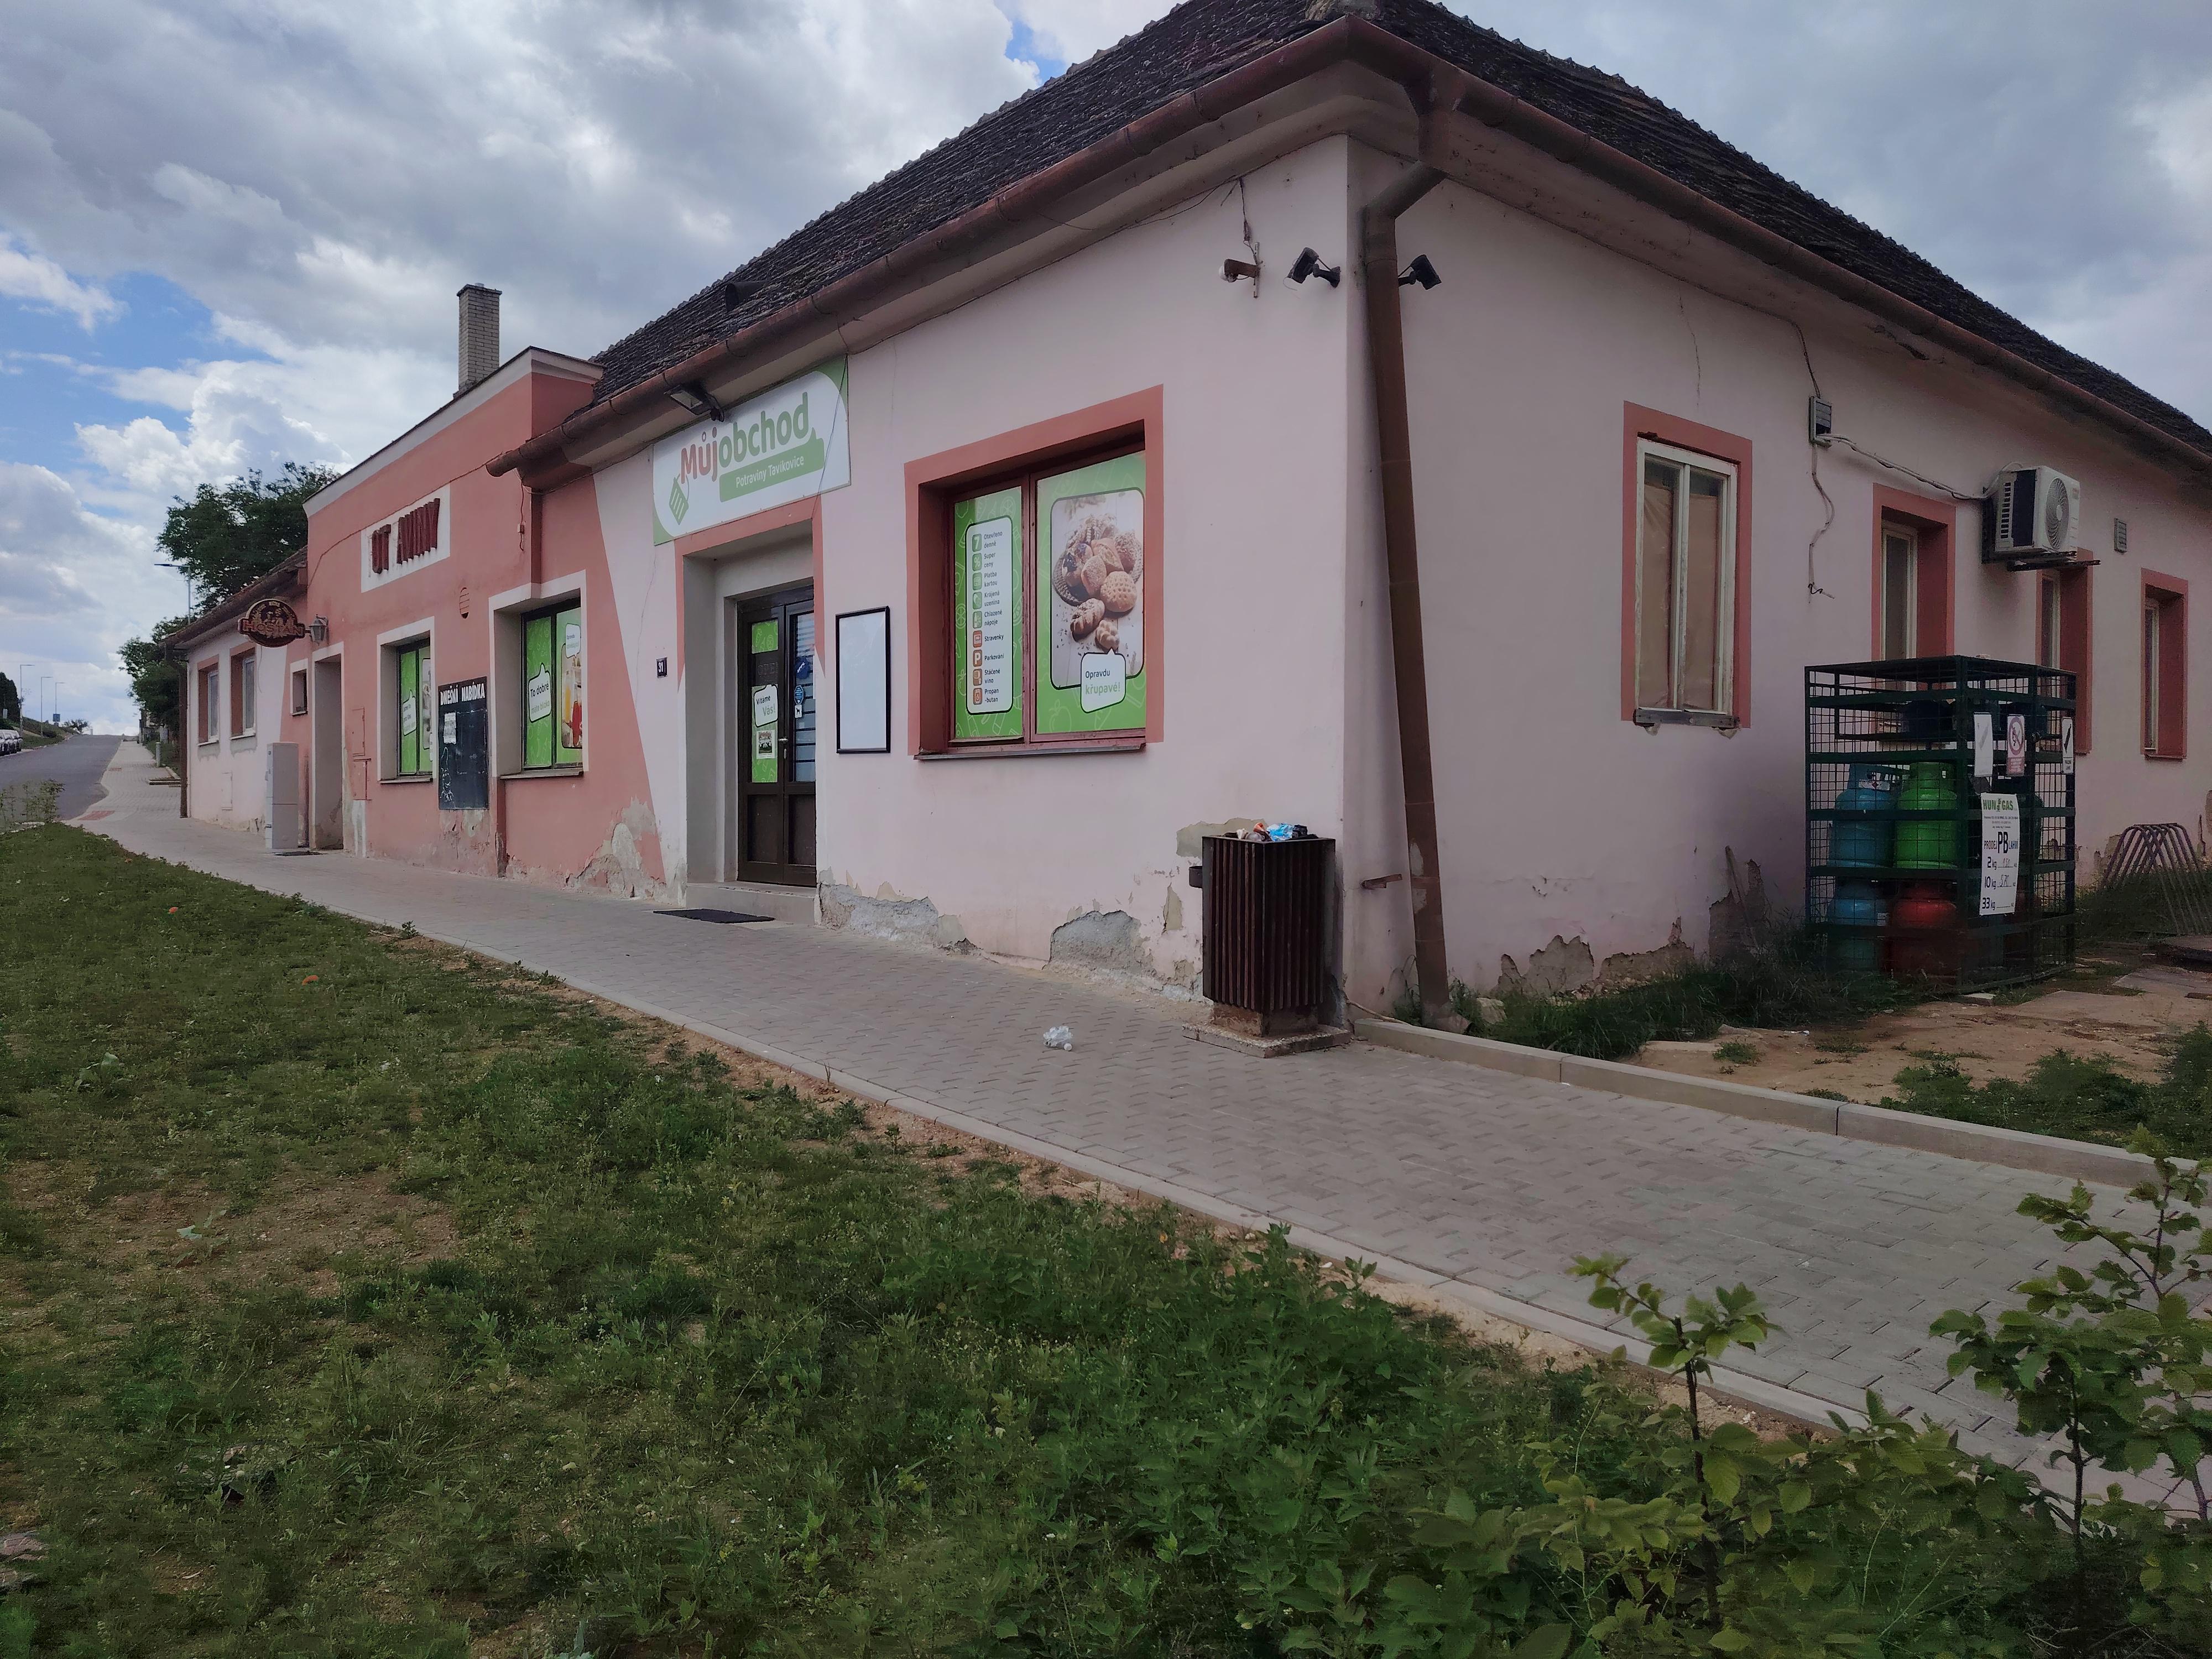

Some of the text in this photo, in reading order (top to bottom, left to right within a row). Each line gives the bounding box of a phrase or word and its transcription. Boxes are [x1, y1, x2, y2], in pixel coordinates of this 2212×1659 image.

[736, 456, 804, 488] Potraviny Tavíkovice
[984, 531, 1003, 540] Otevřeno
[984, 540, 997, 549] denně
[984, 590, 1000, 598] Krájená
[984, 609, 1003, 618] Chlazené
[984, 634, 1004, 642] Stravenky
[984, 653, 1004, 661] Parkování
[1085, 669, 1110, 680] Opravdu
[440, 681, 486, 706] DNEŠNÍ NABÍDKA
[530, 681, 549, 697] To dobré
[1085, 681, 1121, 696] křupavé!
[763, 703, 775, 717] Vás!
[1983, 800, 2013, 811] HUN GAS
[1984, 840, 1997, 849] PRODEJ
[1997, 831, 2008, 854] PB
[1987, 857, 1992, 868] 2
[1992, 859, 1997, 870] kg
[1984, 876, 1991, 888] 10
[1991, 878, 1996, 889] kg
[1981, 897, 1996, 911] 33 kg
